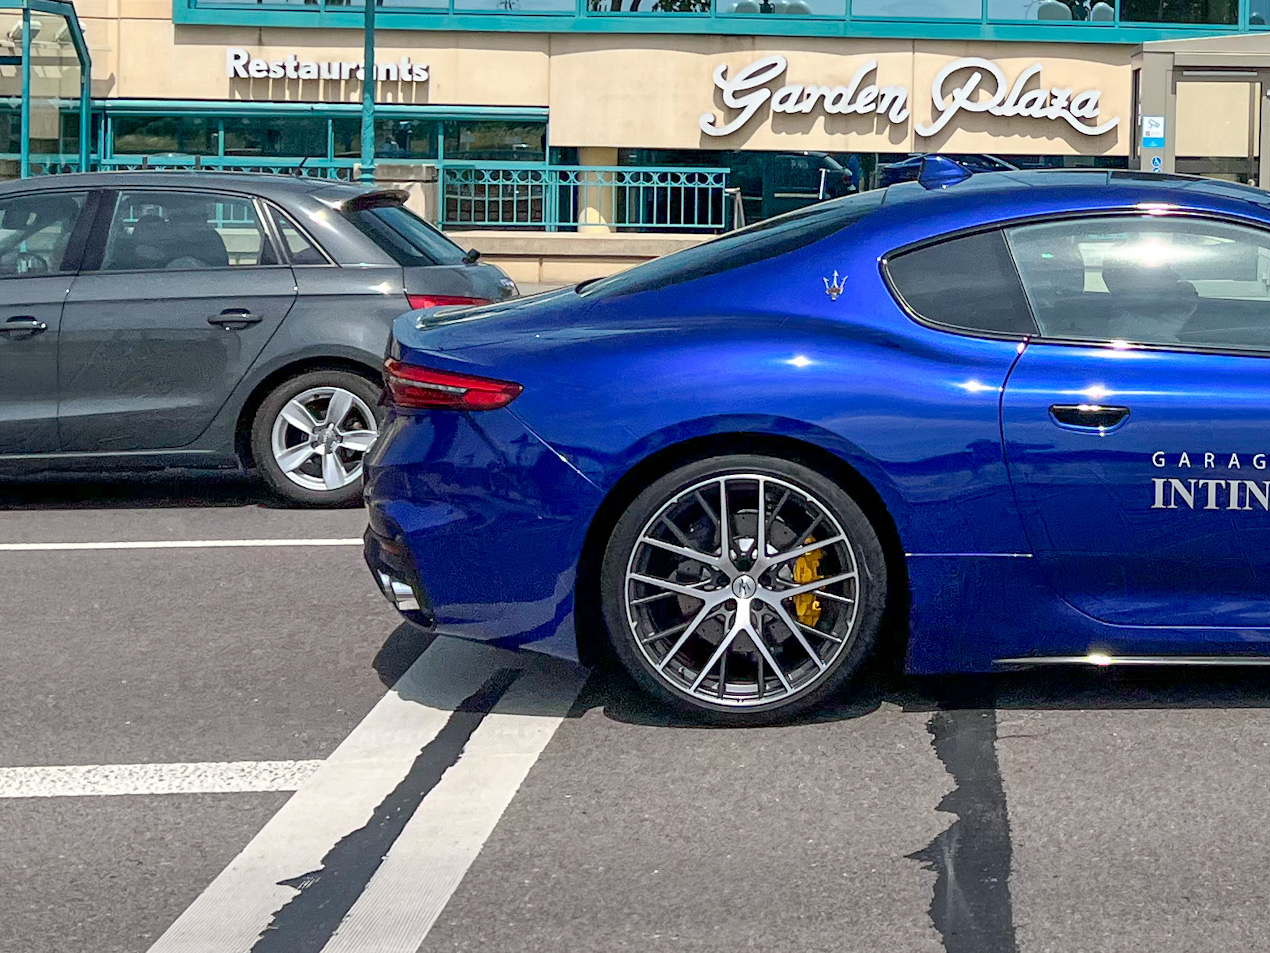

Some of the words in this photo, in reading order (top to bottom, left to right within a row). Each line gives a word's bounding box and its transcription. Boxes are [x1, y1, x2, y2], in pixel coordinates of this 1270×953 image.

[226, 48, 430, 82] Restaurants
[699, 55, 910, 137] Garden
[914, 56, 1120, 137] Plaza
